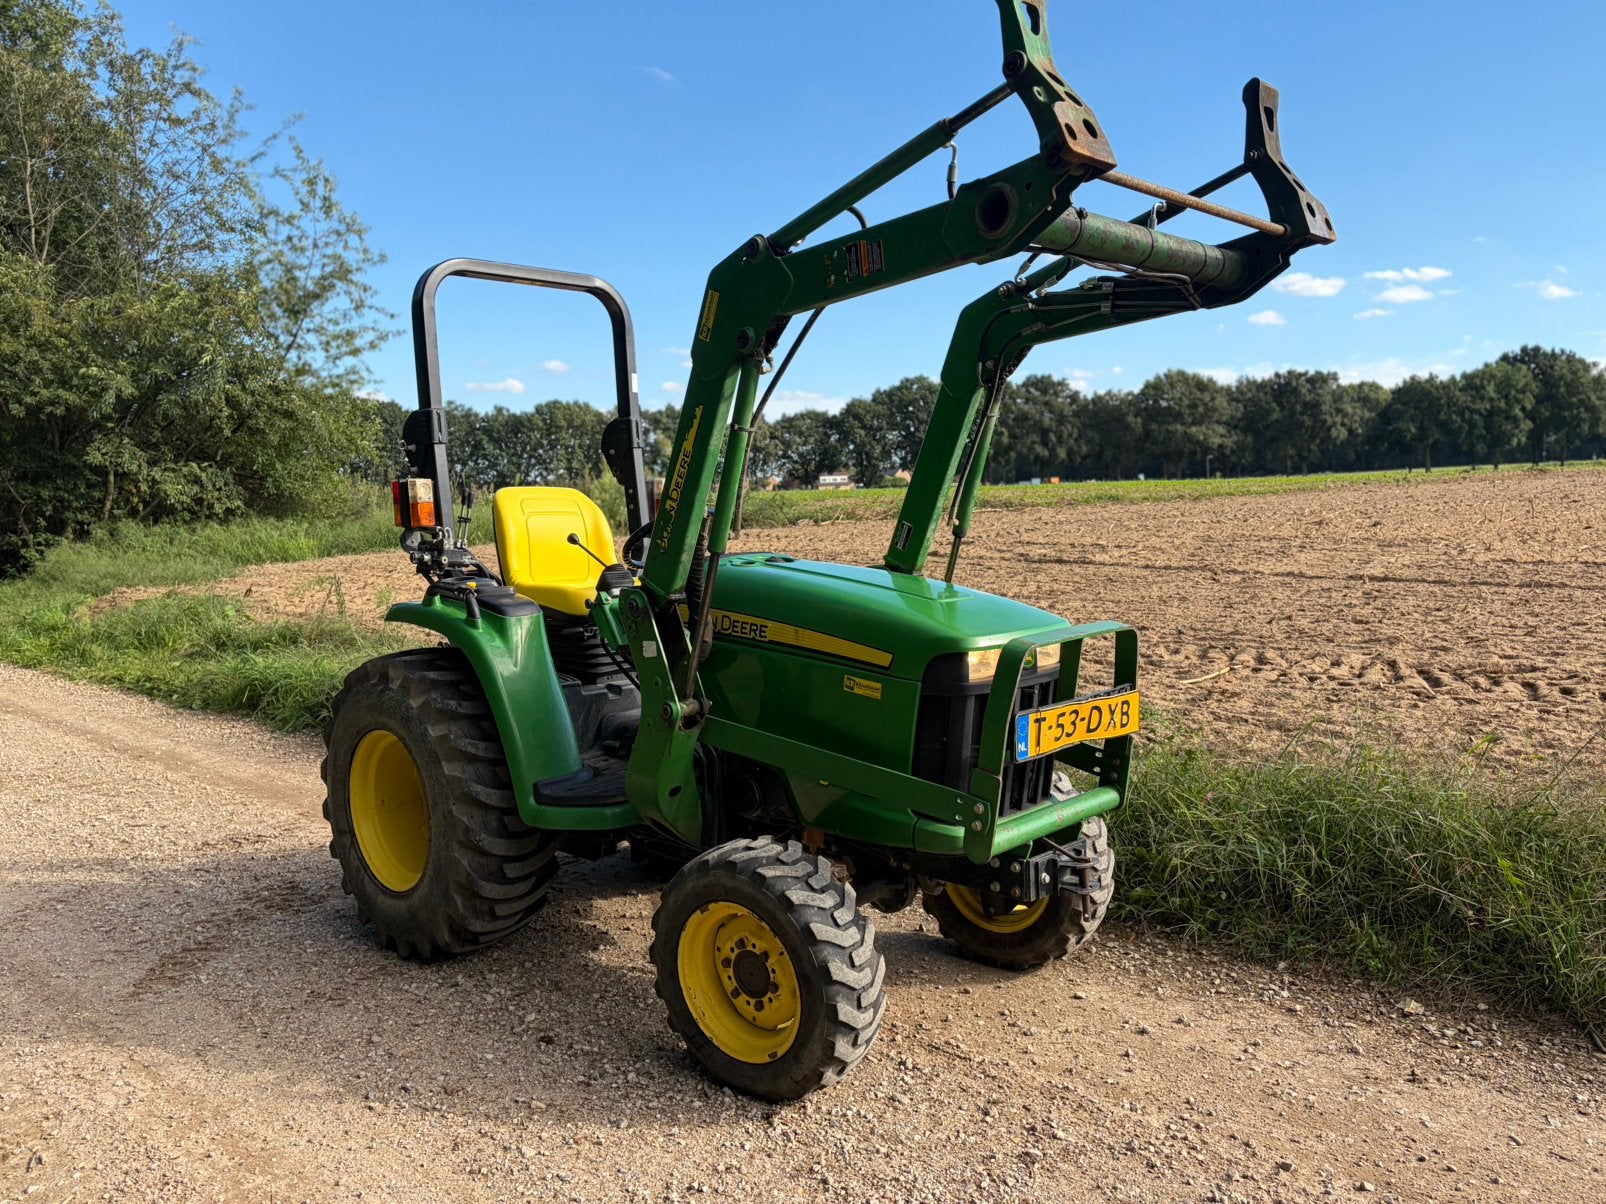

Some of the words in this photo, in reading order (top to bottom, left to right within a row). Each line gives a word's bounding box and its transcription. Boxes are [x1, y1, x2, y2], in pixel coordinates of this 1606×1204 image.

[670, 449, 692, 503] DEERE
[721, 615, 769, 639] DEERE
[1033, 700, 1131, 748] T-53-DXB
[1018, 741, 1027, 752] NL
